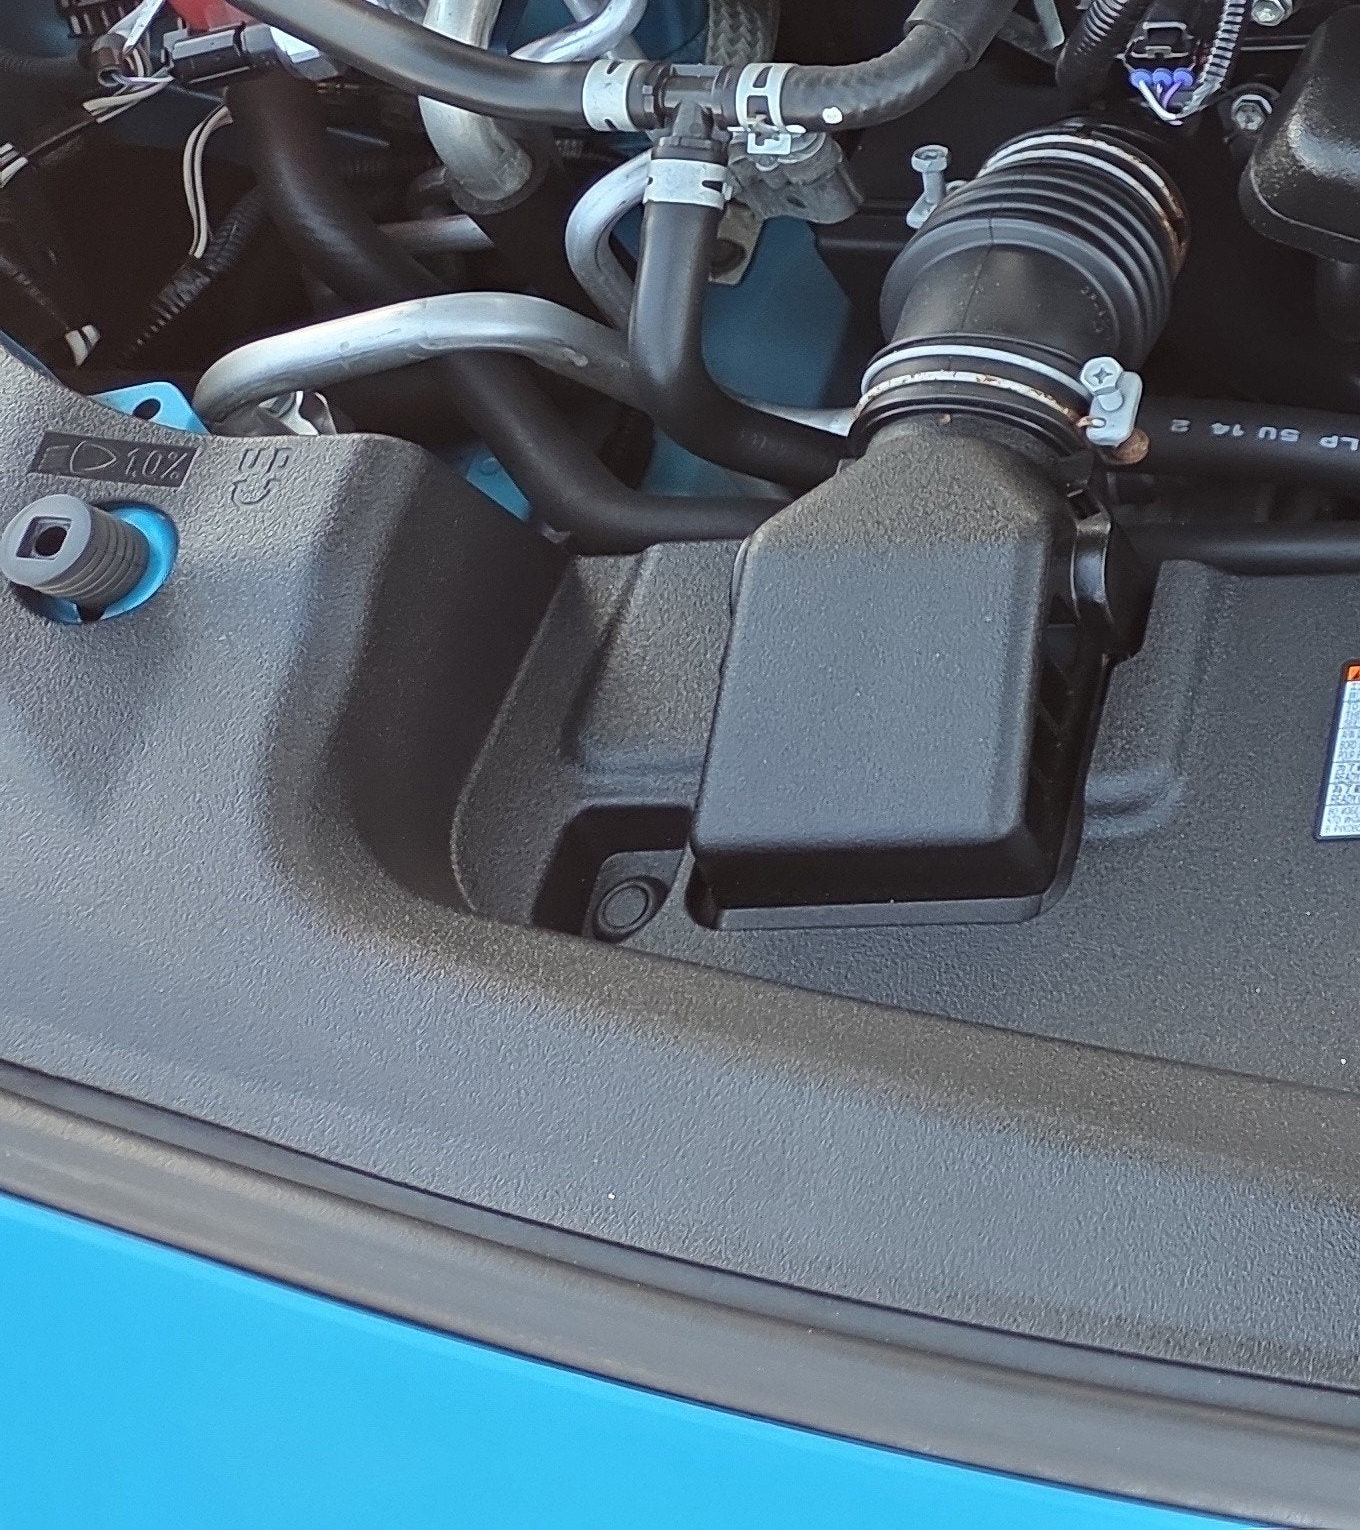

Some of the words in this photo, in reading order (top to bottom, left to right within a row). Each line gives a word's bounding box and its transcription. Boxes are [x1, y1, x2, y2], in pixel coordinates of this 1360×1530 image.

[1170, 419, 1191, 433] 2
[1210, 421, 1245, 437] 14
[1318, 435, 1360, 451] LP
[124, 446, 188, 481] 1.0%
